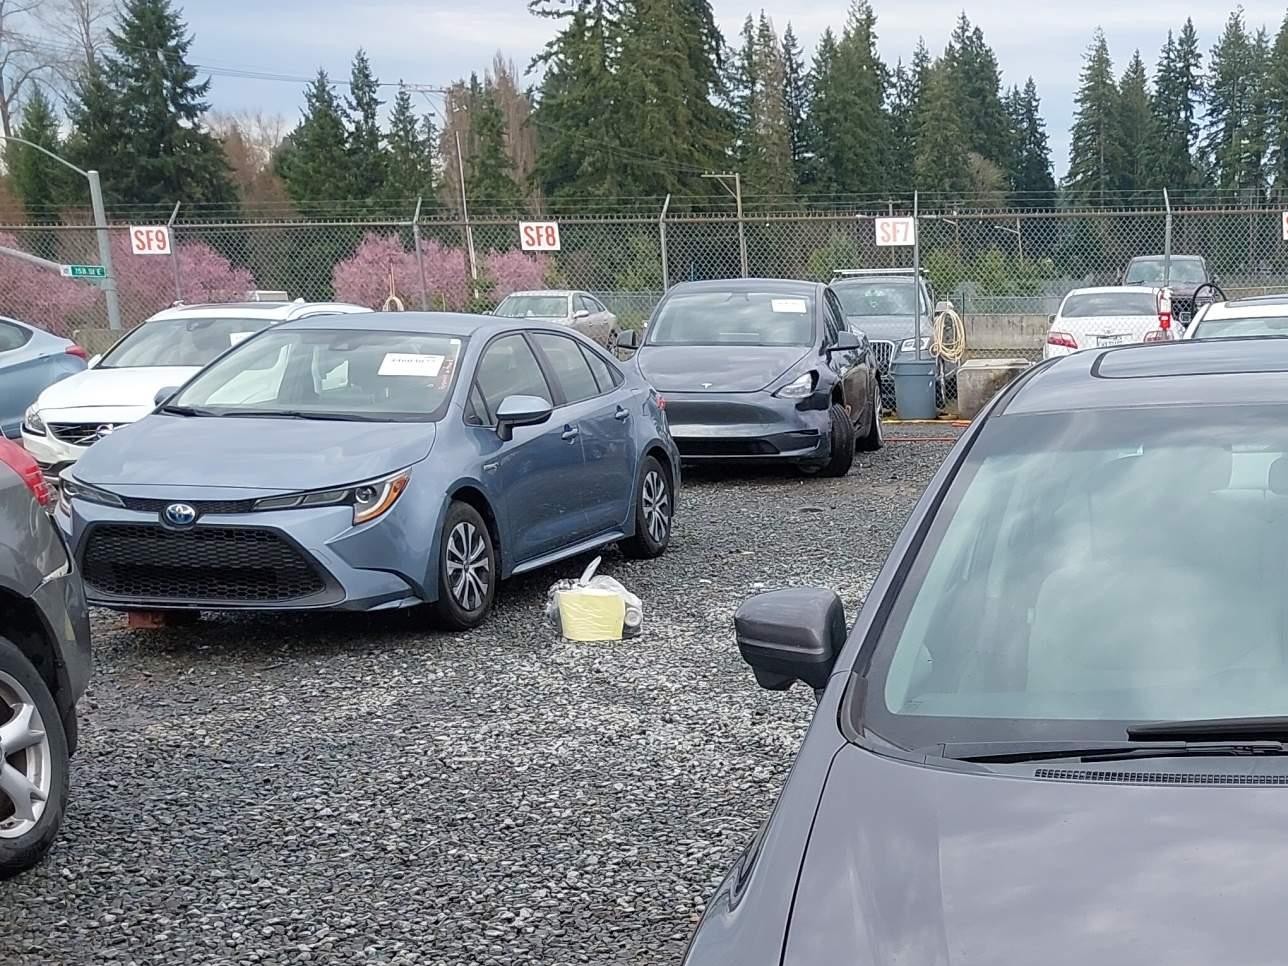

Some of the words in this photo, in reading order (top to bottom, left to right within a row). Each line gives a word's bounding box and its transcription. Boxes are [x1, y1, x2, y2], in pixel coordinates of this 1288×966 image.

[133, 229, 167, 251] SF9
[523, 225, 556, 247] SF8
[880, 221, 910, 243] SF7
